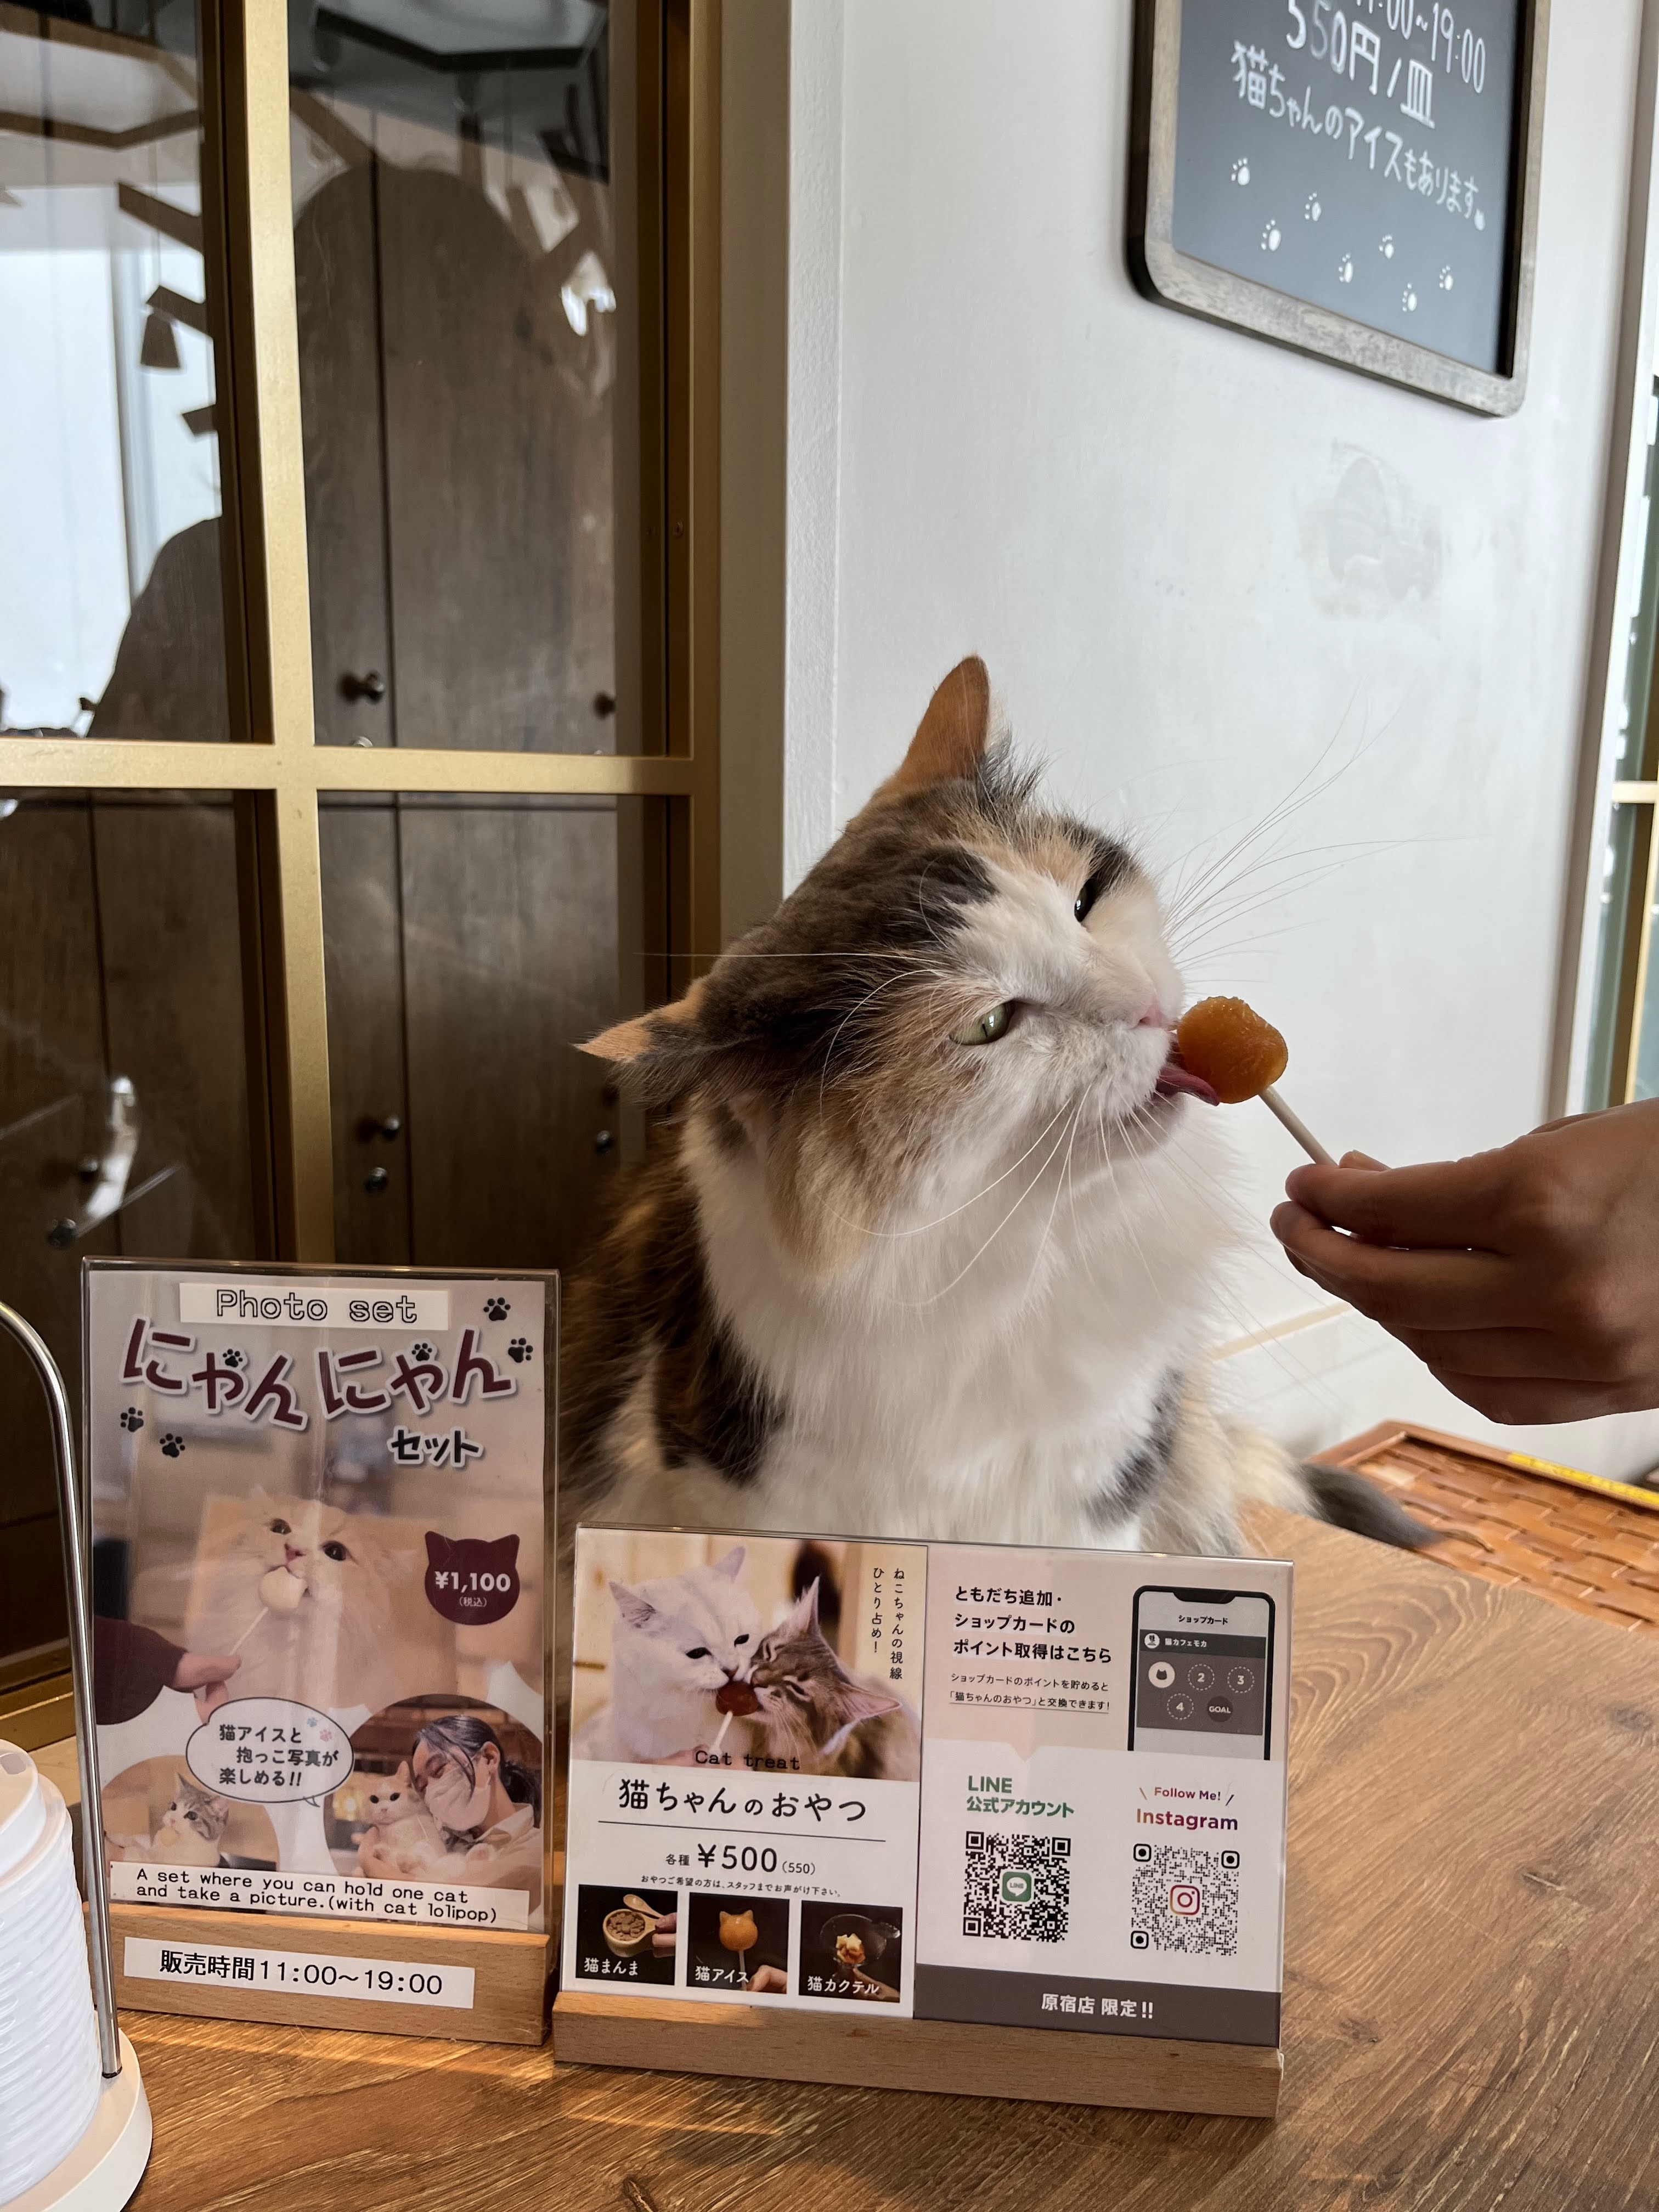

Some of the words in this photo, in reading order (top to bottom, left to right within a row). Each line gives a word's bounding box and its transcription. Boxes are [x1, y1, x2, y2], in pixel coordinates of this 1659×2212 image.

[217, 1289, 328, 1322] Photo
[349, 1295, 417, 1324] set
[391, 1429, 479, 1464] セット
[435, 1571, 511, 1593] ¥1,100
[871, 1567, 884, 1654] ひとり占め!
[1178, 1615, 1228, 1625] ショップカード
[889, 1567, 905, 1680] ねこちゃんの視線
[954, 1613, 1075, 1634] ショップカードの
[953, 1639, 1113, 1664] ポイント取得はこちら
[951, 1673, 1109, 1692] ショップカードのポイントを貯めると
[1197, 1672, 1205, 1683] 2
[1237, 1675, 1245, 1685] 3
[1176, 1702, 1184, 1712] 4
[1209, 1706, 1231, 1714] GOAL
[219, 1724, 302, 1744] 猫アイスと
[236, 1746, 339, 1768] 抱っこ写真が
[695, 1750, 732, 1765] Cat
[744, 1753, 800, 1770] treat
[219, 1768, 302, 1787] 楽しめる!!
[968, 1775, 1013, 1793] LINE
[618, 1778, 866, 1822] 猫ちゃんのおやつ
[1154, 1786, 1195, 1799] Follow
[1199, 1788, 1221, 1802] Me!
[967, 1796, 1075, 1818] 公式アカウント
[1136, 1808, 1238, 1831] Instagram
[665, 1854, 690, 1866] 各種
[698, 1843, 777, 1872] ¥500
[782, 1860, 816, 1875] (550)
[137, 1869, 148, 1880] A
[158, 1871, 189, 1883] set
[200, 1872, 252, 1887] where
[263, 1878, 294, 1891] you
[303, 1882, 335, 1893] can
[345, 1881, 382, 1897] hold
[393, 1888, 424, 1900] one
[435, 1891, 468, 1903] cat
[137, 1885, 167, 1897] and
[178, 1886, 220, 1901] take
[230, 1892, 240, 1902] a
[385, 1903, 417, 1915] cat
[428, 1903, 496, 1923] lolipop)
[584, 1957, 639, 1976] 猫まんま
[695, 1965, 749, 1983] 猫アイス
[807, 1976, 879, 1995] 猫カクテル
[1042, 1993, 1095, 2015] 原宿店
